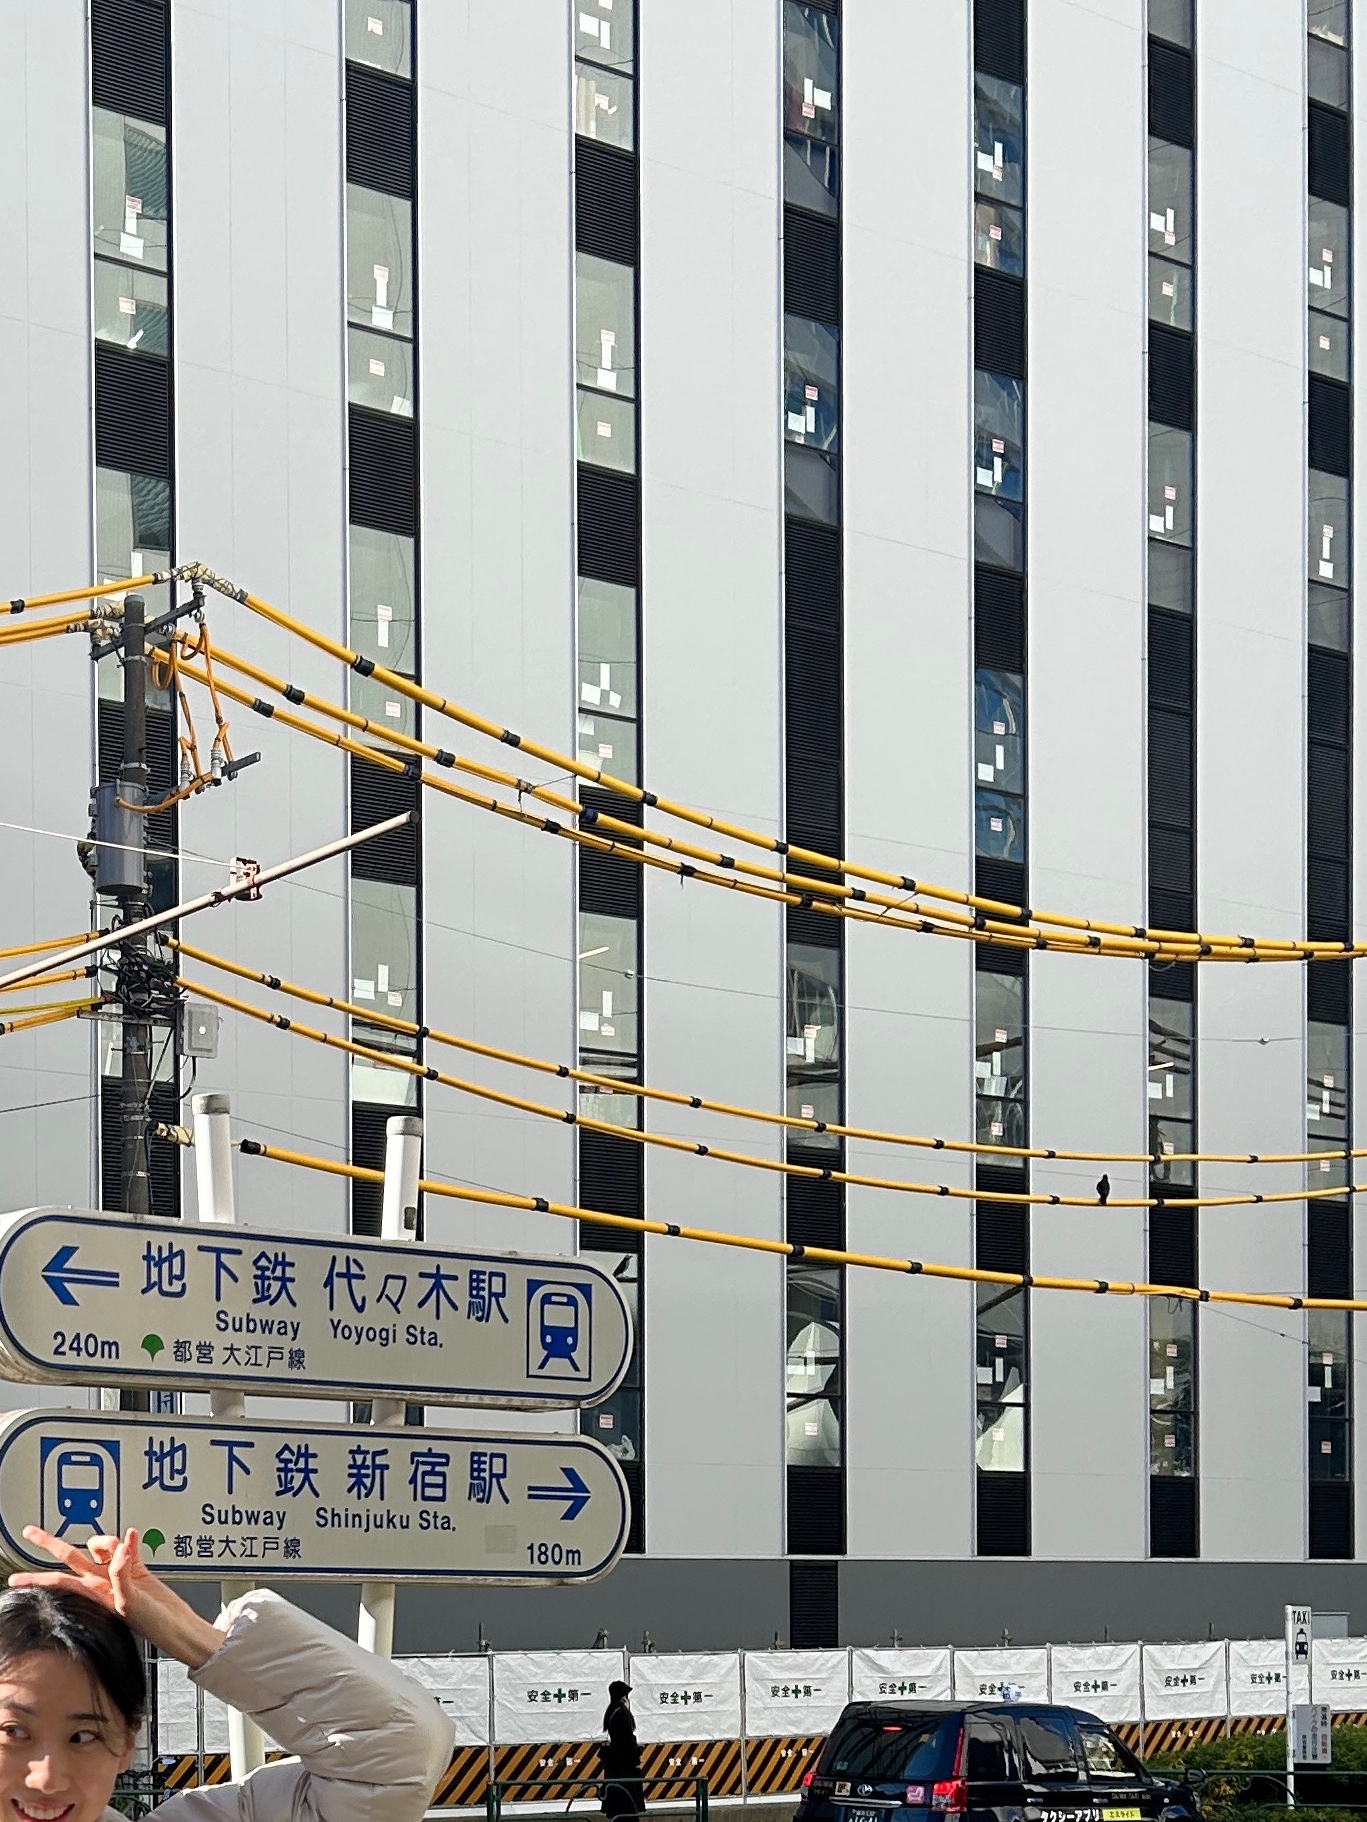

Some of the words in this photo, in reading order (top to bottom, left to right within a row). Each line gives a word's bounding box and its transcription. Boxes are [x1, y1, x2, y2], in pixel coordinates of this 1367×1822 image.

[141, 1240, 297, 1308] 地下鉄
[323, 1254, 509, 1324] 代々木駅
[215, 1309, 301, 1340] Subway
[329, 1318, 397, 1348] Yoyogi
[405, 1323, 444, 1349] Sta.
[52, 1331, 120, 1360] 240m
[172, 1338, 215, 1365] 都営
[222, 1342, 307, 1371] 大江戸線
[142, 1436, 510, 1505] 地下鉄新宿駅
[201, 1503, 287, 1531] Subway
[315, 1507, 410, 1533] Shinjuku
[418, 1509, 457, 1532] Sta.
[173, 1533, 302, 1559] 都営大江戸線
[527, 1542, 582, 1566] 180m
[1292, 1610, 1311, 1625] TAXI
[526, 1689, 552, 1703] 安全
[567, 1689, 592, 1702] 第一
[659, 1691, 680, 1705] 安全
[770, 1685, 791, 1698] 安全
